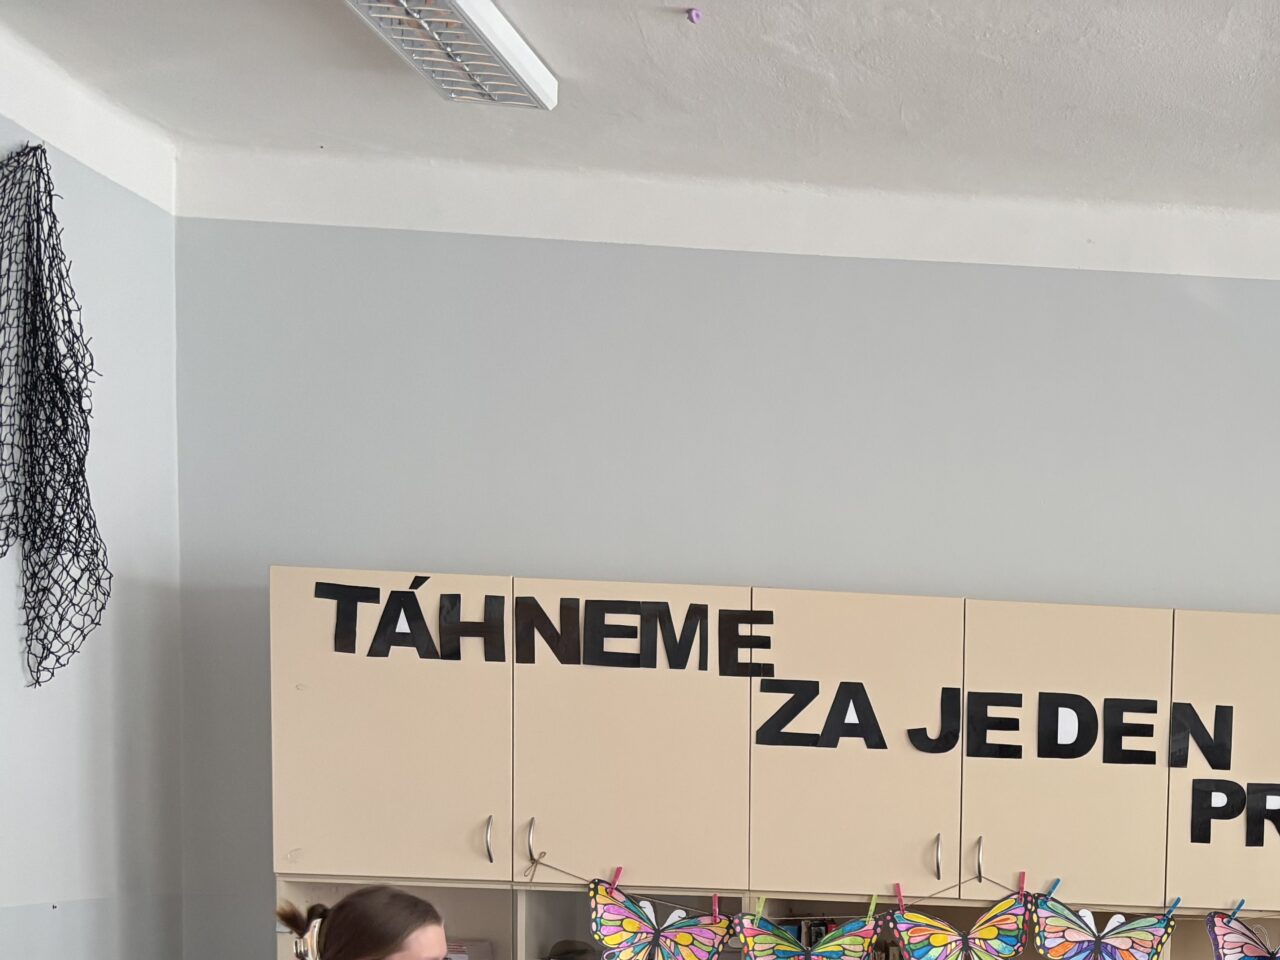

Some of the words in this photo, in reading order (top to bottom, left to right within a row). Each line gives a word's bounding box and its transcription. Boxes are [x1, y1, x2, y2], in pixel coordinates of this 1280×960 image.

[315, 576, 774, 677] TÁHNEME
[755, 679, 887, 749] ZA
[907, 687, 1233, 770] JEDEN
